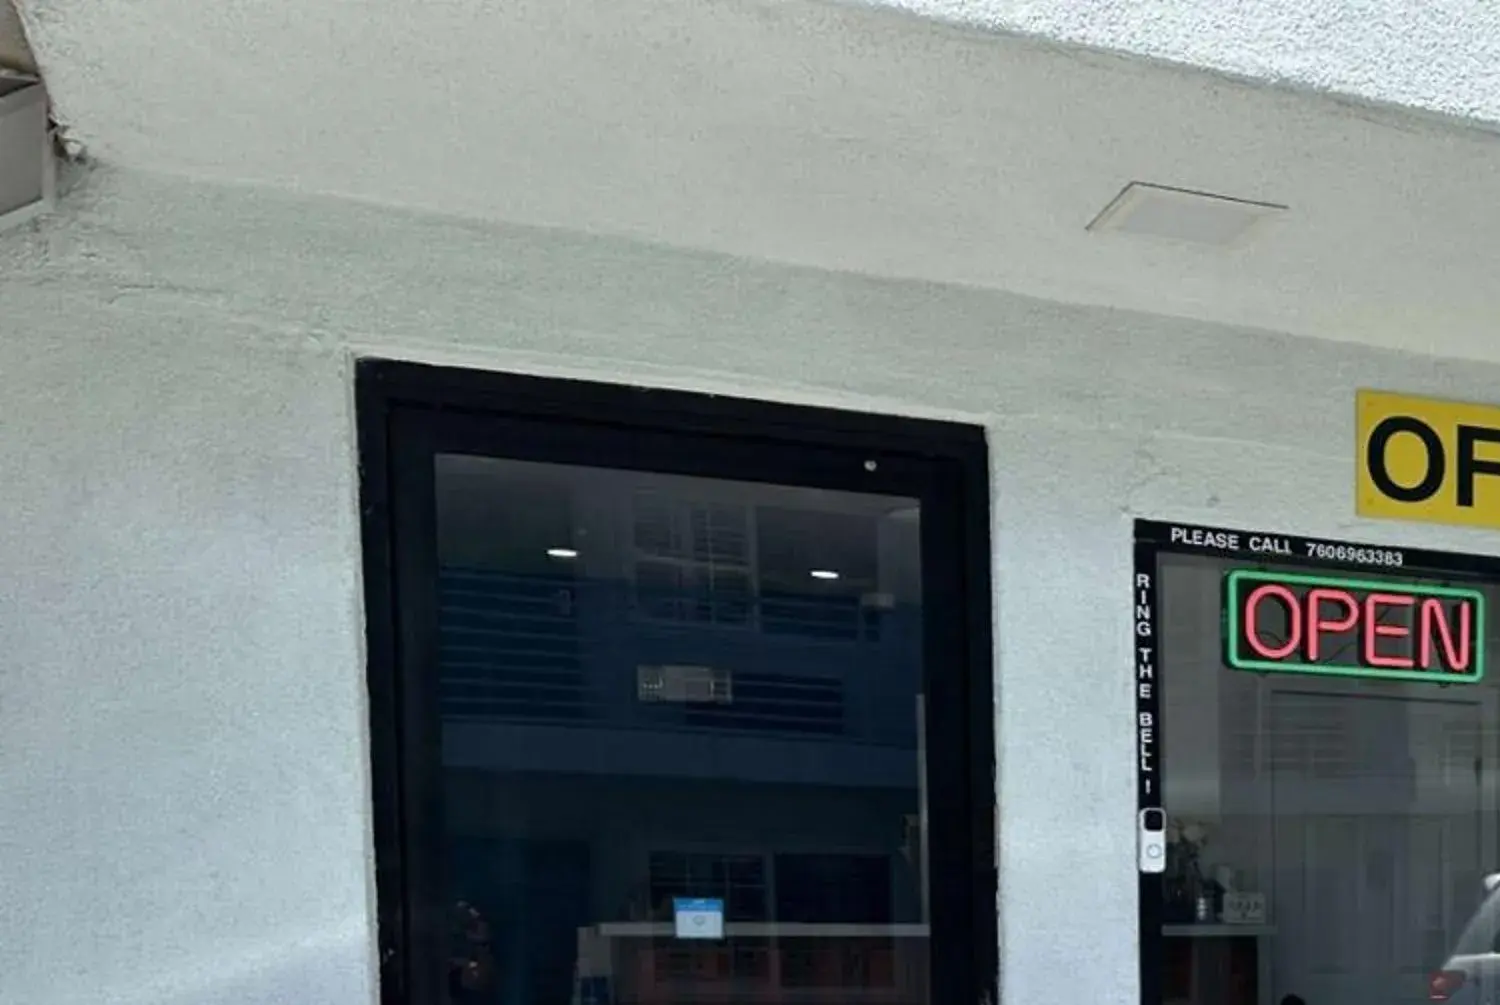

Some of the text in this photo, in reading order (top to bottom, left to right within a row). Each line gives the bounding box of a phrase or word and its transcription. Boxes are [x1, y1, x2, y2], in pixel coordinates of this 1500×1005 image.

[1171, 527, 1239, 550] PLEASE
[1249, 537, 1292, 554] CALL
[1136, 573, 1152, 636] RING
[1244, 583, 1471, 672] OPEN
[1138, 647, 1153, 699] THE
[1139, 712, 1153, 771] BELL
